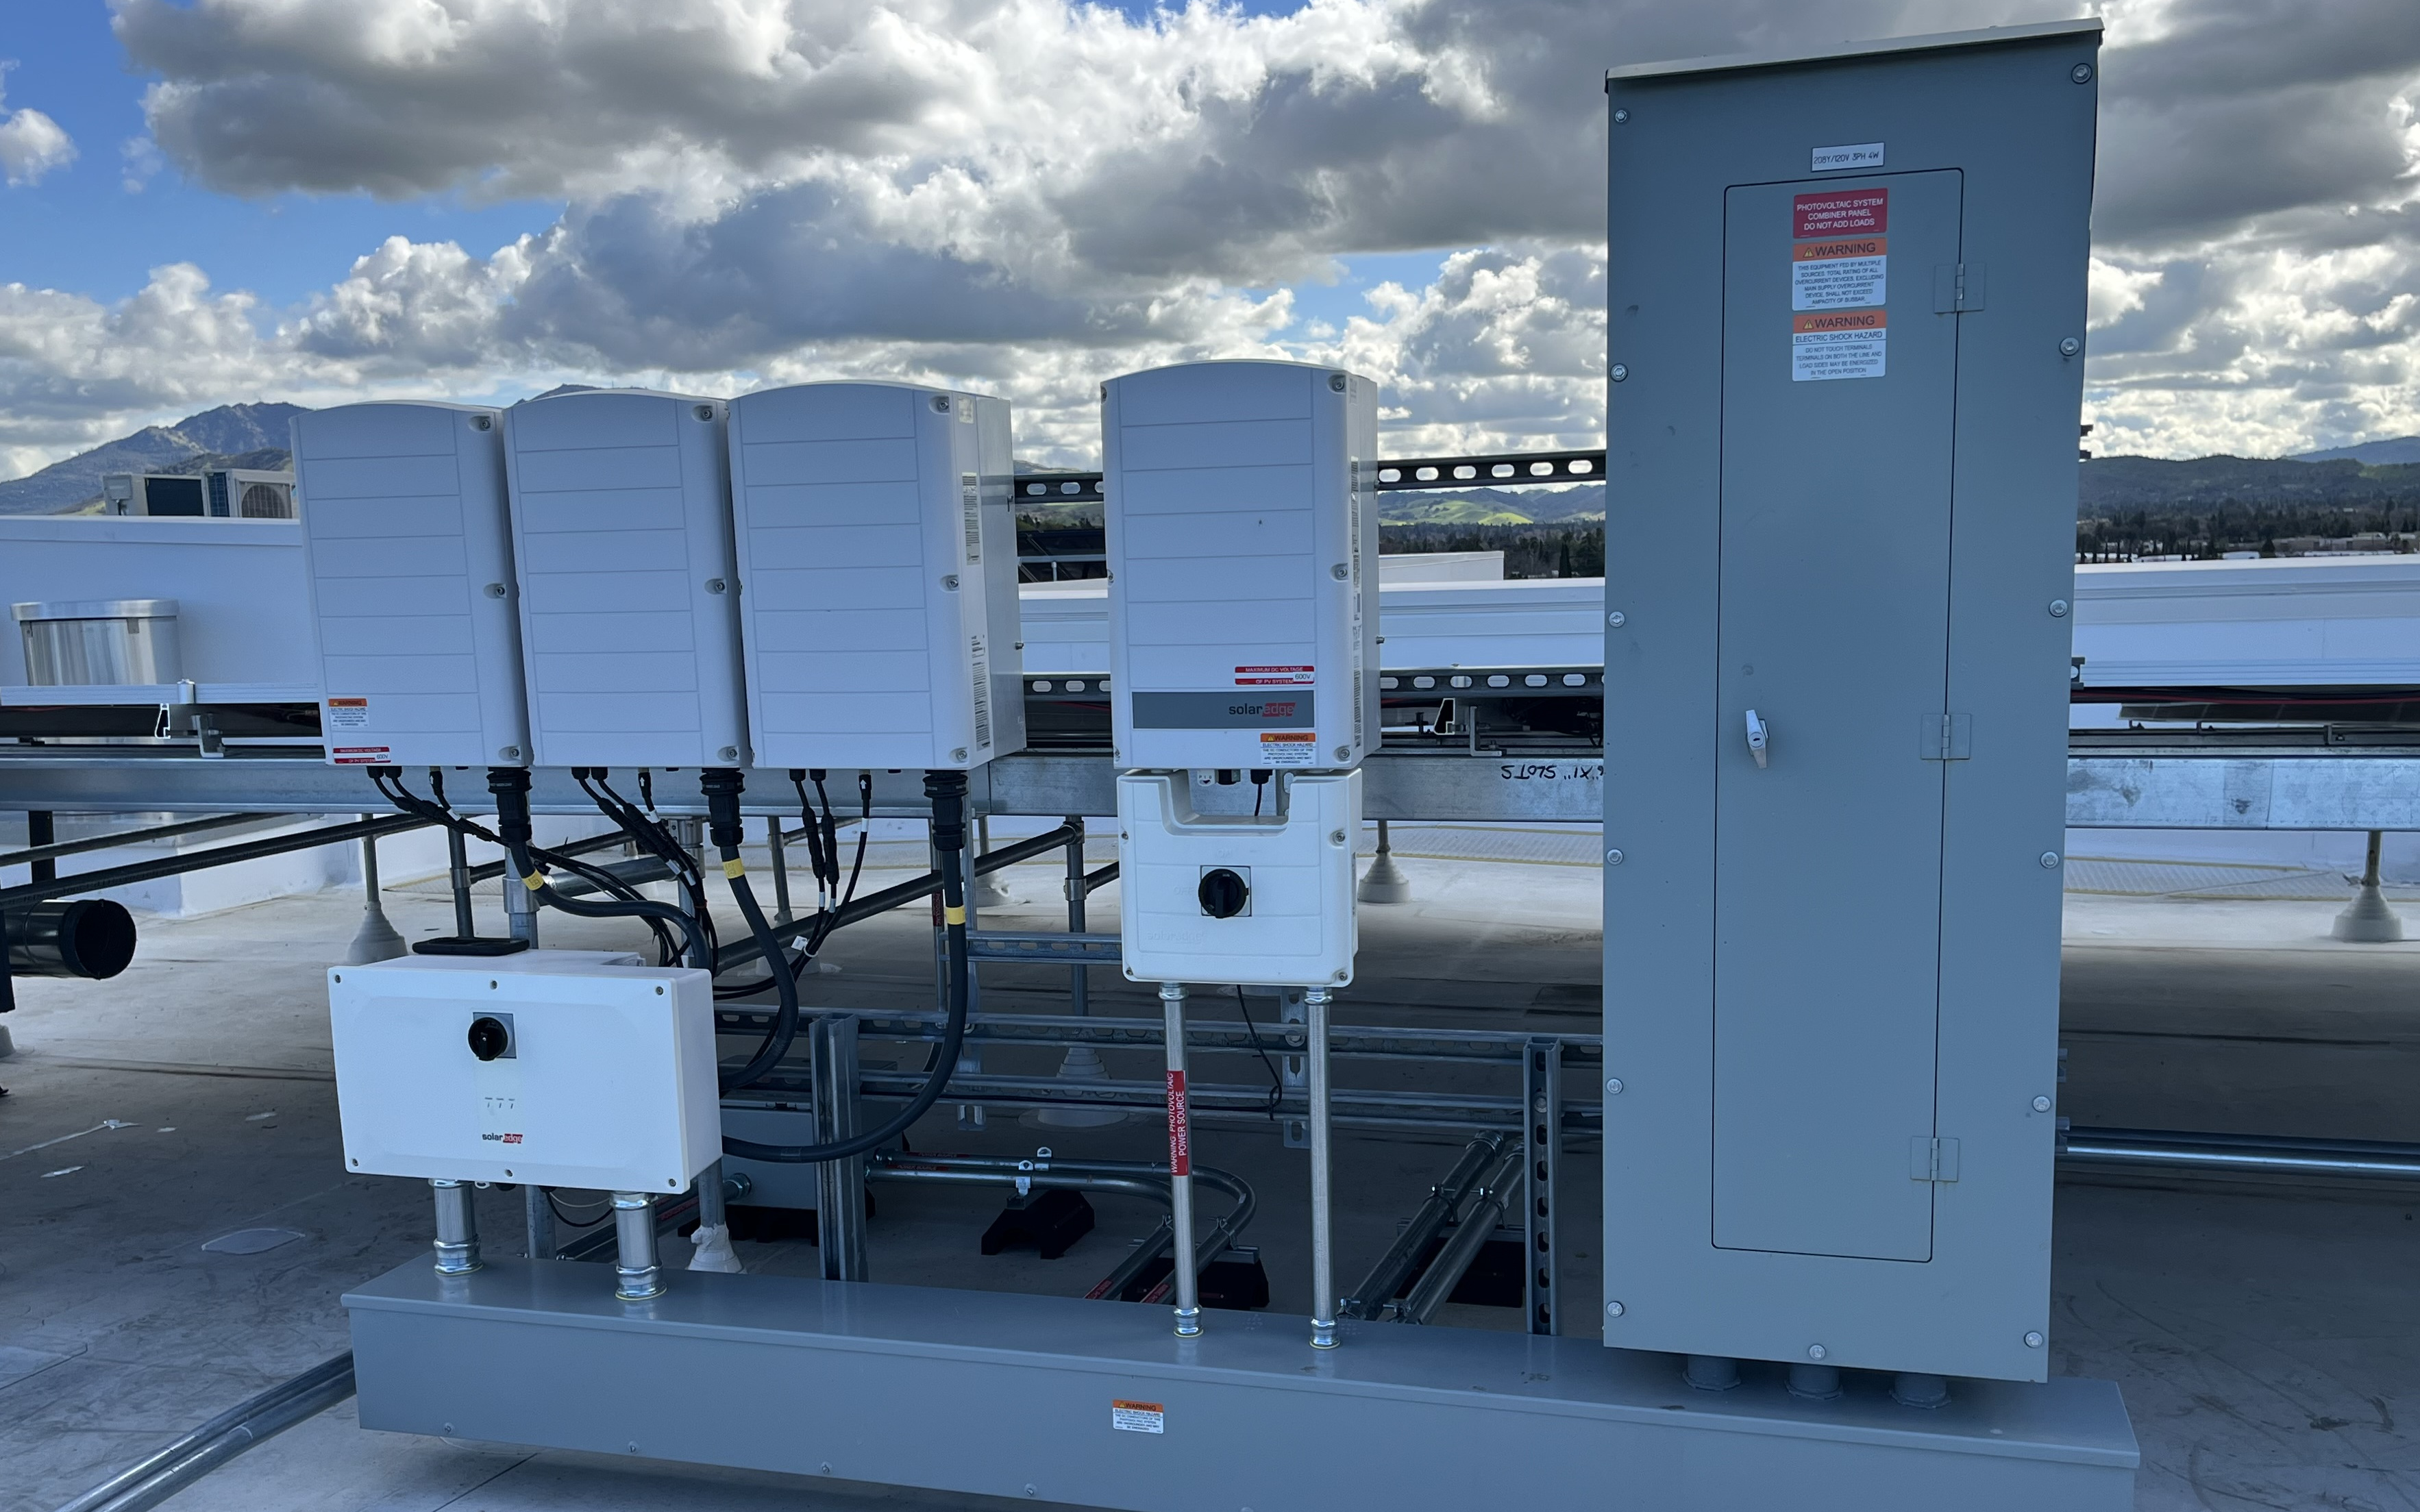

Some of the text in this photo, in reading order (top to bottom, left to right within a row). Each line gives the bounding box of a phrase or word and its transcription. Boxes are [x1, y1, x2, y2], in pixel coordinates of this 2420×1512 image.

[1814, 154, 1849, 164] 208Y/120V
[1852, 153, 1866, 161] 3PH
[1797, 198, 1884, 211] PHOTOVOLTAIC SYSTEM
[1808, 209, 1871, 221] COMBINER PANEL
[1816, 221, 1831, 230] NOT
[1833, 220, 1849, 228] ADD
[1850, 219, 1875, 227] LOADS
[1816, 243, 1876, 256] WARNING
[1815, 315, 1875, 328] WARNING
[1795, 334, 1828, 343] ELECTRIC
[1854, 331, 1882, 339] HAZARD
[1228, 702, 1296, 717] solaredge
[1501, 765, 1557, 780] SLOTS
[1167, 1072, 1176, 1132] PHOTOVOLTAIC
[1176, 1091, 1187, 1156] POWER SOURCE
[482, 1132, 523, 1144] solaredge
[1126, 1402, 1156, 1411] WARNING
